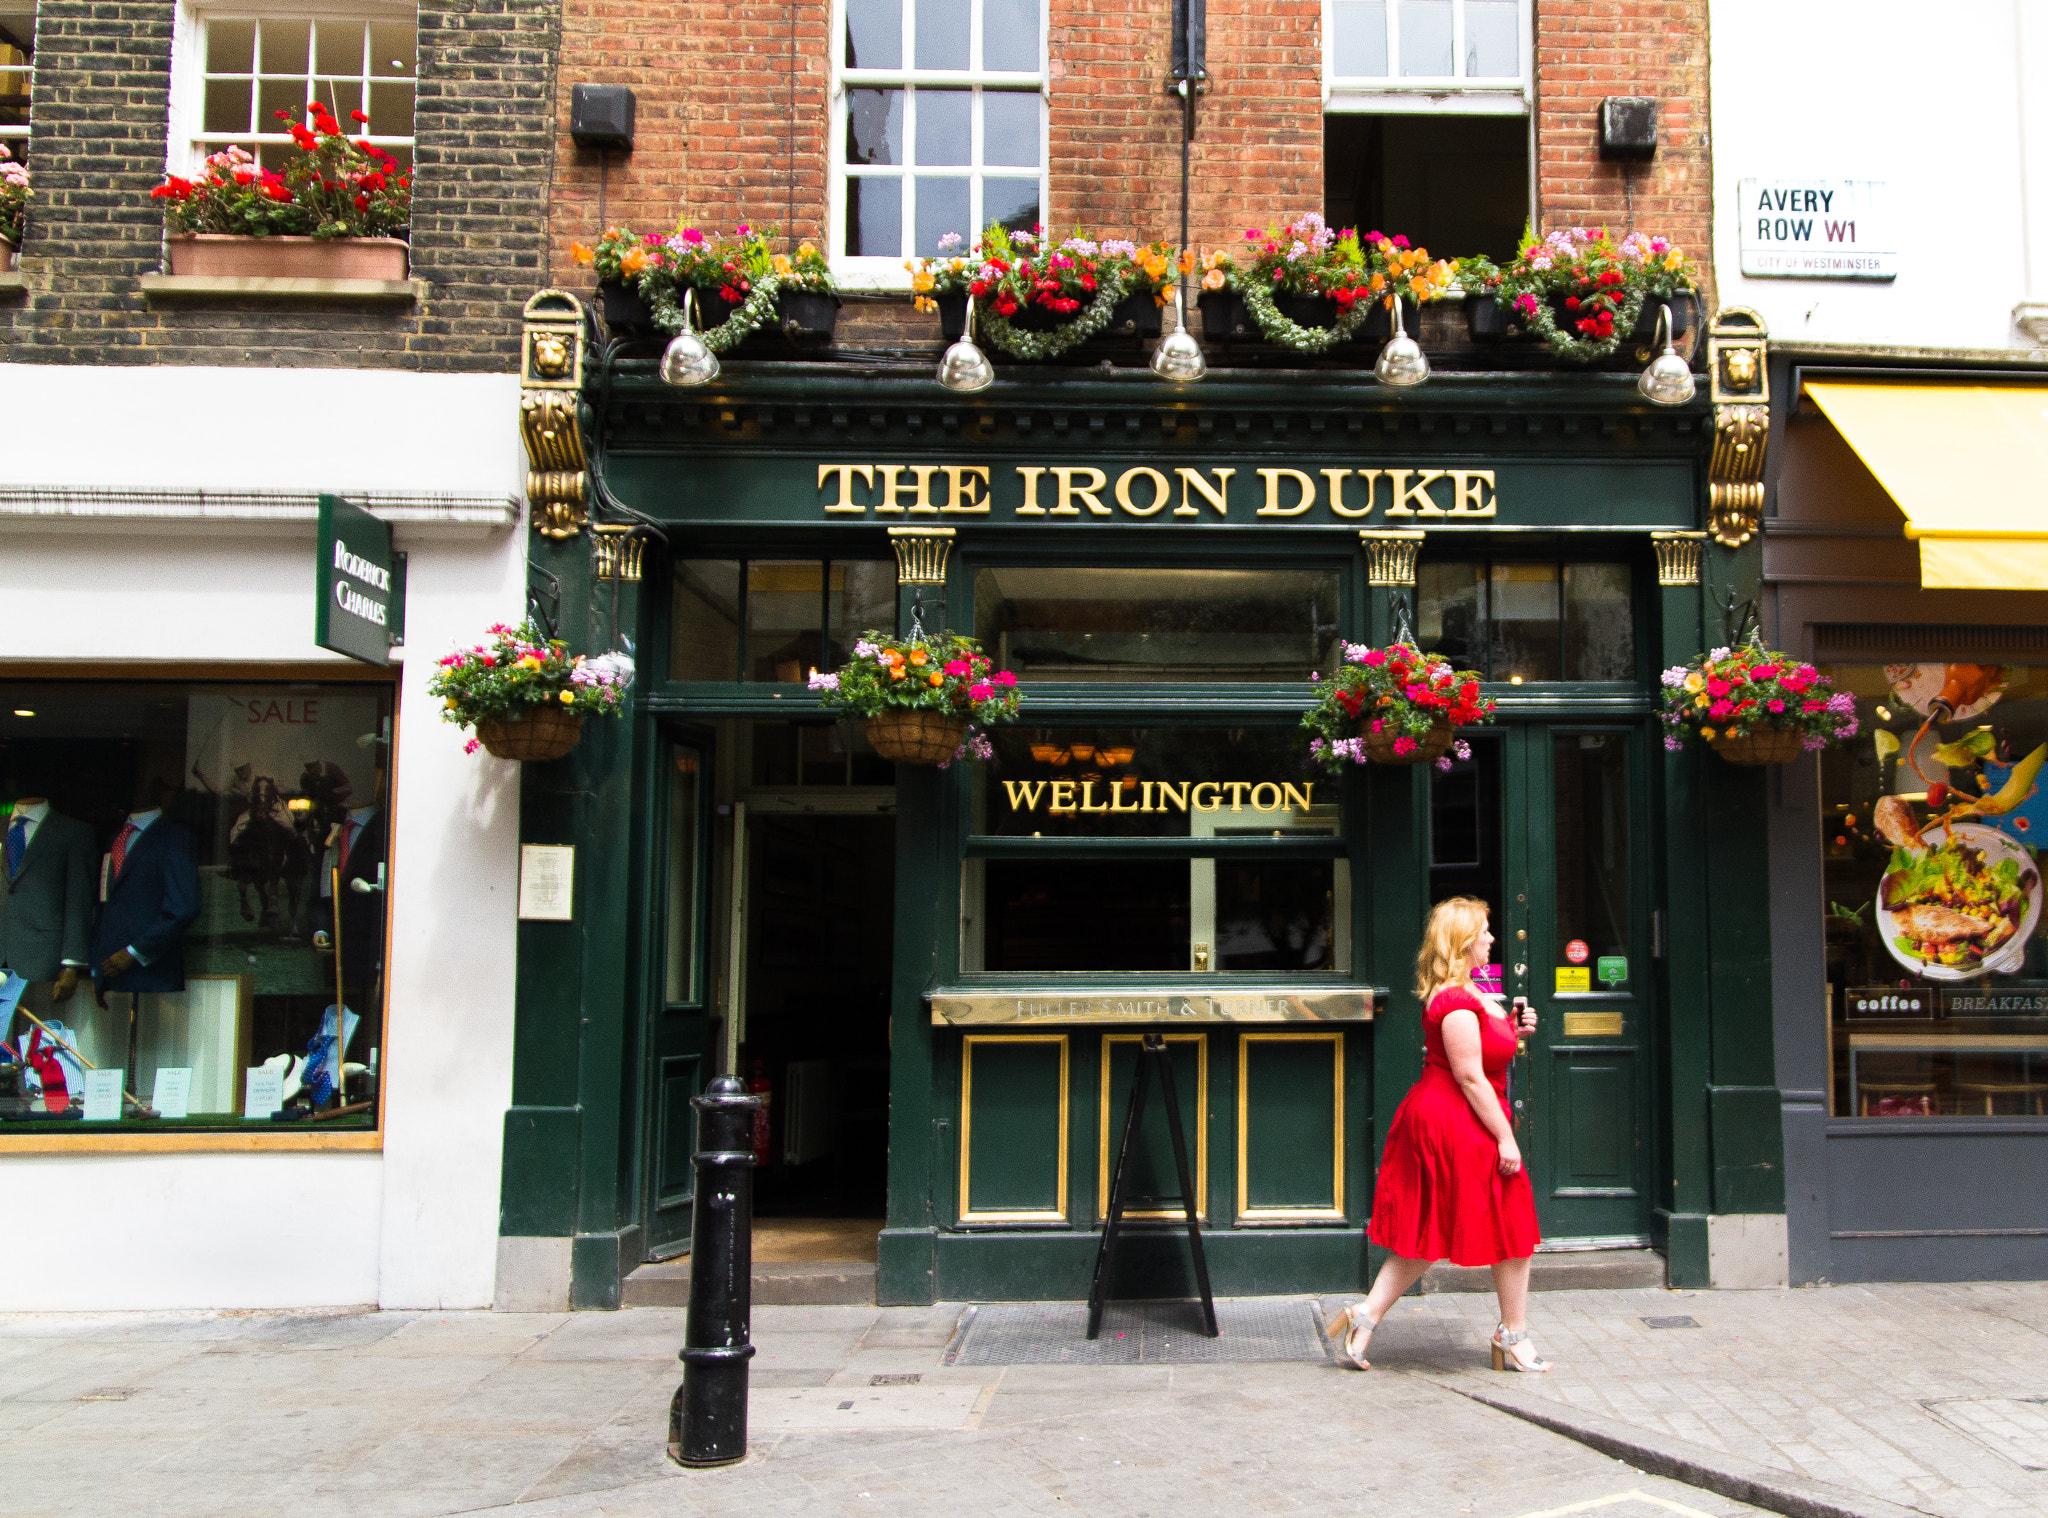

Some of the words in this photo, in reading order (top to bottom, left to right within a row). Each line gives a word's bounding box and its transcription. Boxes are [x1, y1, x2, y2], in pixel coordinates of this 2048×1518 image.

[1757, 188, 1834, 213] AVERY
[1757, 218, 1813, 241] ROW
[1824, 219, 1856, 242] W1
[1757, 256, 1781, 268] CITY
[1785, 257, 1798, 269] OF
[1803, 257, 1881, 270] WESTMINSTER
[817, 463, 992, 514] THE
[1014, 466, 1237, 517] IRON
[1256, 468, 1498, 519] DUKE
[334, 539, 391, 592] RODERICK
[335, 580, 387, 626] CHARLES
[247, 699, 318, 724] SALE
[1002, 780, 1315, 813] WELLINGTON
[1017, 1000, 1091, 1018] FULLER
[1101, 998, 1170, 1017] SMITH
[1180, 999, 1197, 1017] &
[1206, 998, 1290, 1016] TURNER
[1856, 995, 1921, 1013] coffee
